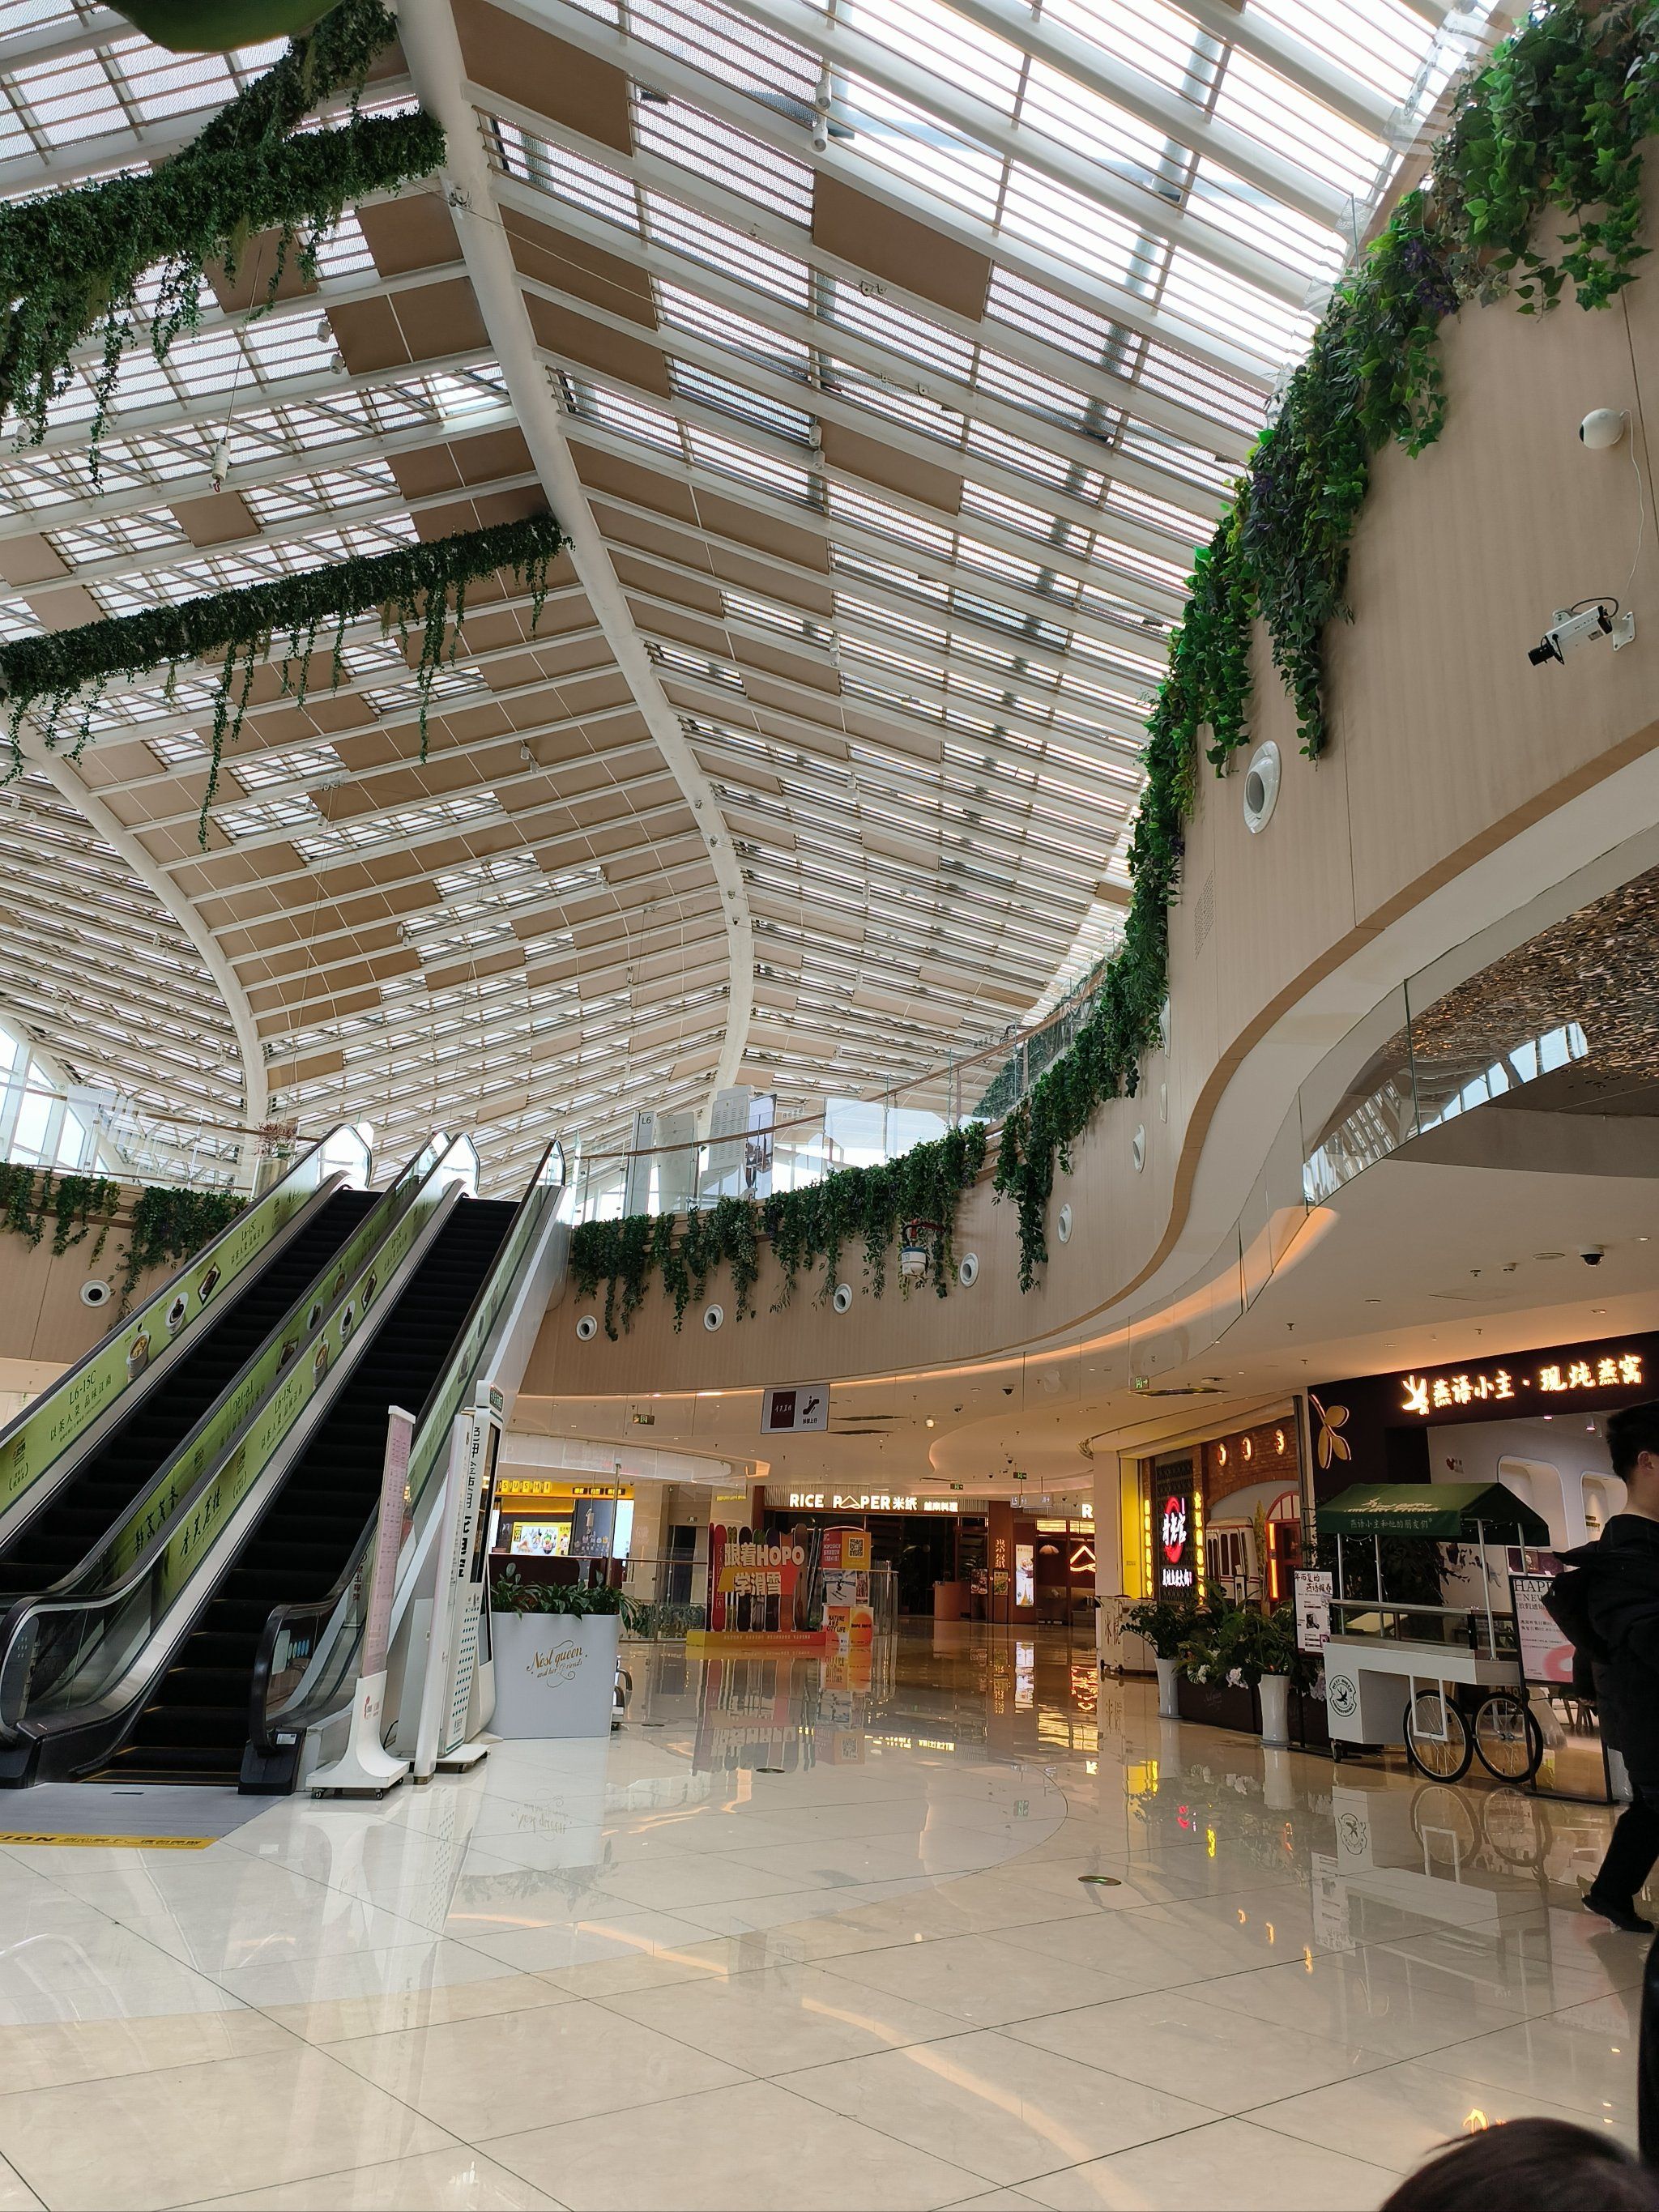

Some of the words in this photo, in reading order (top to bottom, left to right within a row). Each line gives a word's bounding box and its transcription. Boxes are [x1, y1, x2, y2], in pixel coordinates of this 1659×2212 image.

[642, 1116, 651, 1124] L6
[69, 1370, 96, 1406] L6-15C
[502, 1481, 550, 1491] SUSHI
[789, 1493, 824, 1508] RICE
[892, 1496, 918, 1511] 米纸
[723, 1542, 805, 1567] 跟着HOPO
[734, 1571, 782, 1596] 学滑雪
